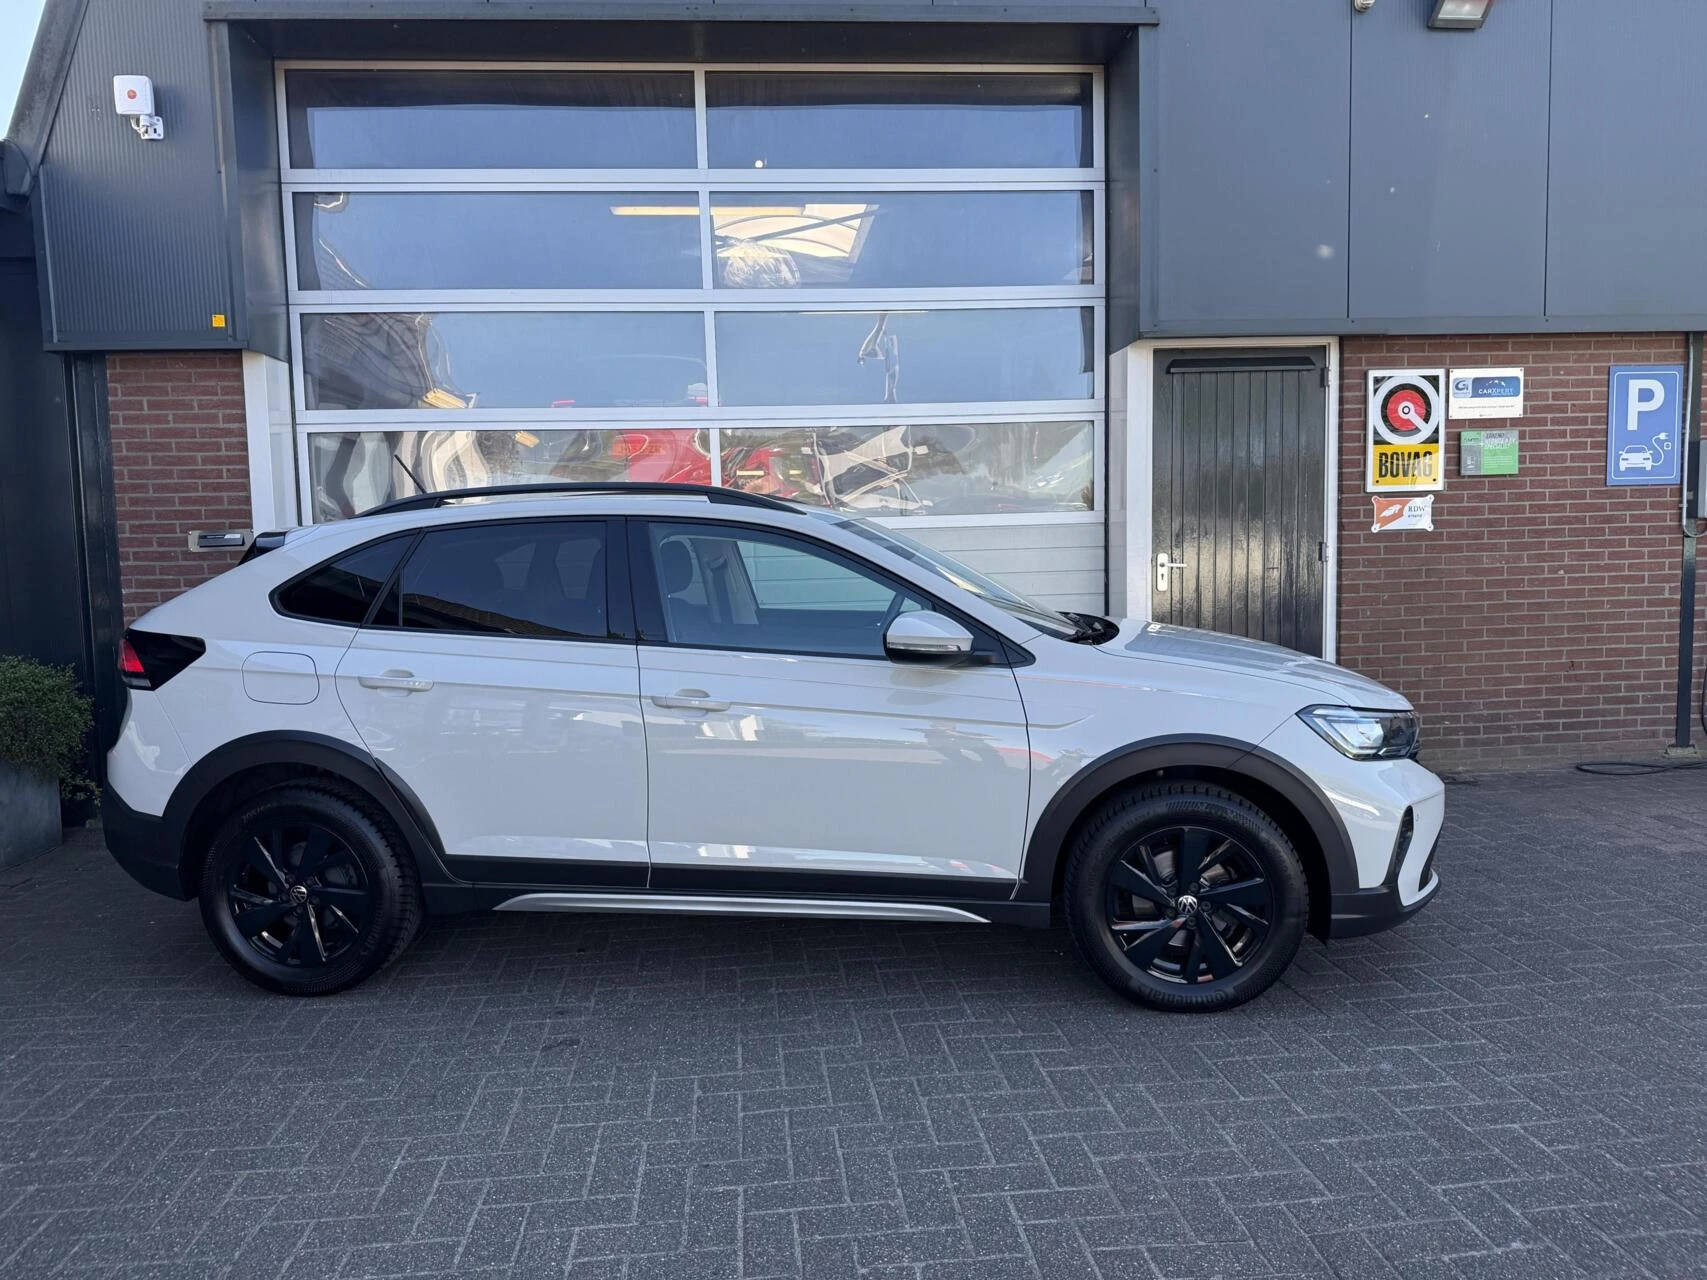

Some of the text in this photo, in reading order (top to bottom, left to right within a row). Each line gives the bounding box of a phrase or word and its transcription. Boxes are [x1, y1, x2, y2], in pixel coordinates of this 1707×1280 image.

[1627, 379, 1665, 431] P
[1378, 451, 1433, 478] BOVAG
[1408, 505, 1427, 513] RDW
